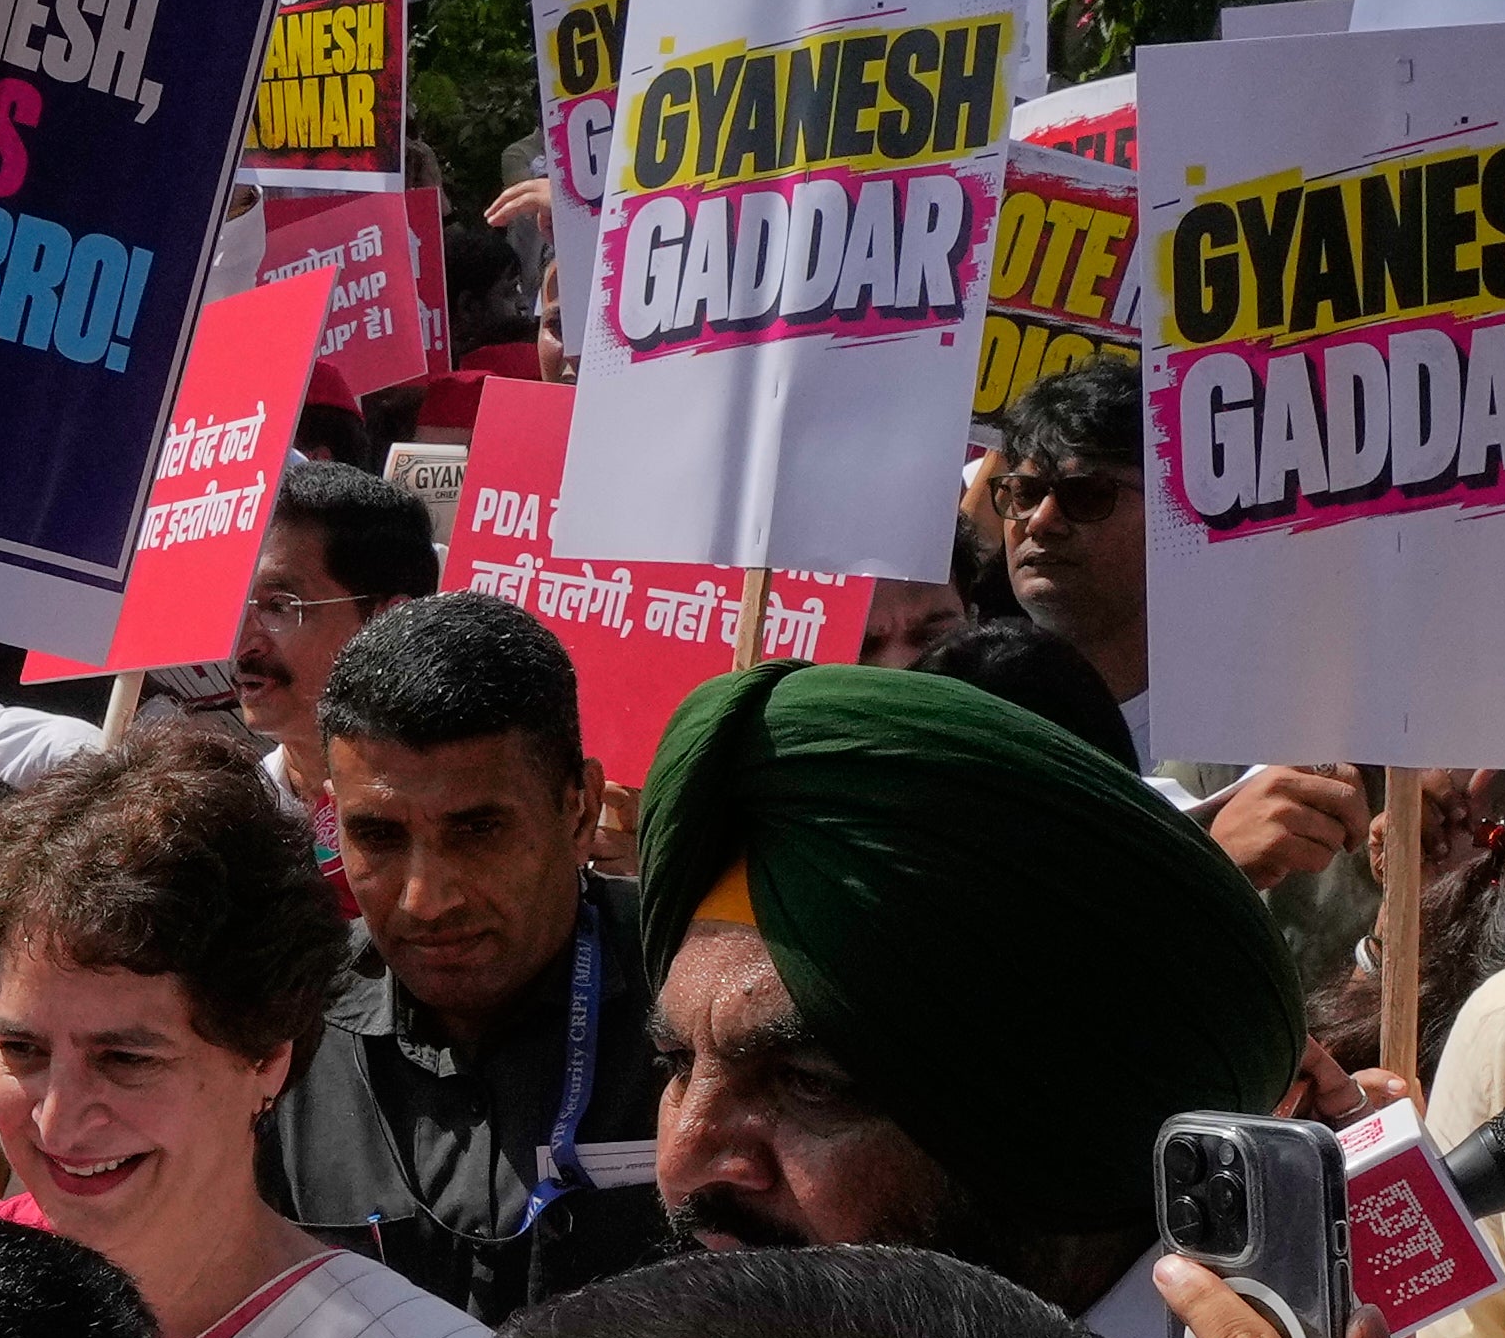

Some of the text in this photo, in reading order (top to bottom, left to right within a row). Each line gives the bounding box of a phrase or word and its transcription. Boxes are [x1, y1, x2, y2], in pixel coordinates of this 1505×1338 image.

[264, 2, 385, 80] ANESH
[634, 23, 1001, 189] GYANESH
[349, 224, 383, 263] की
[618, 175, 967, 346] GADDAR
[988, 191, 1132, 319] OTE
[331, 271, 387, 314] AMP
[190, 414, 225, 472] बंद
[218, 400, 267, 466] करो
[163, 479, 244, 552] इस्तीफा
[236, 470, 267, 533] दो
[414, 465, 468, 490] GYAN
[471, 487, 541, 542] PDA
[537, 563, 634, 639] चलेगी,
[645, 580, 724, 644] नहीं
[569, 991, 590, 1042] CRPF
[560, 1046, 589, 1120] Security
[552, 1122, 567, 1151] VIP
